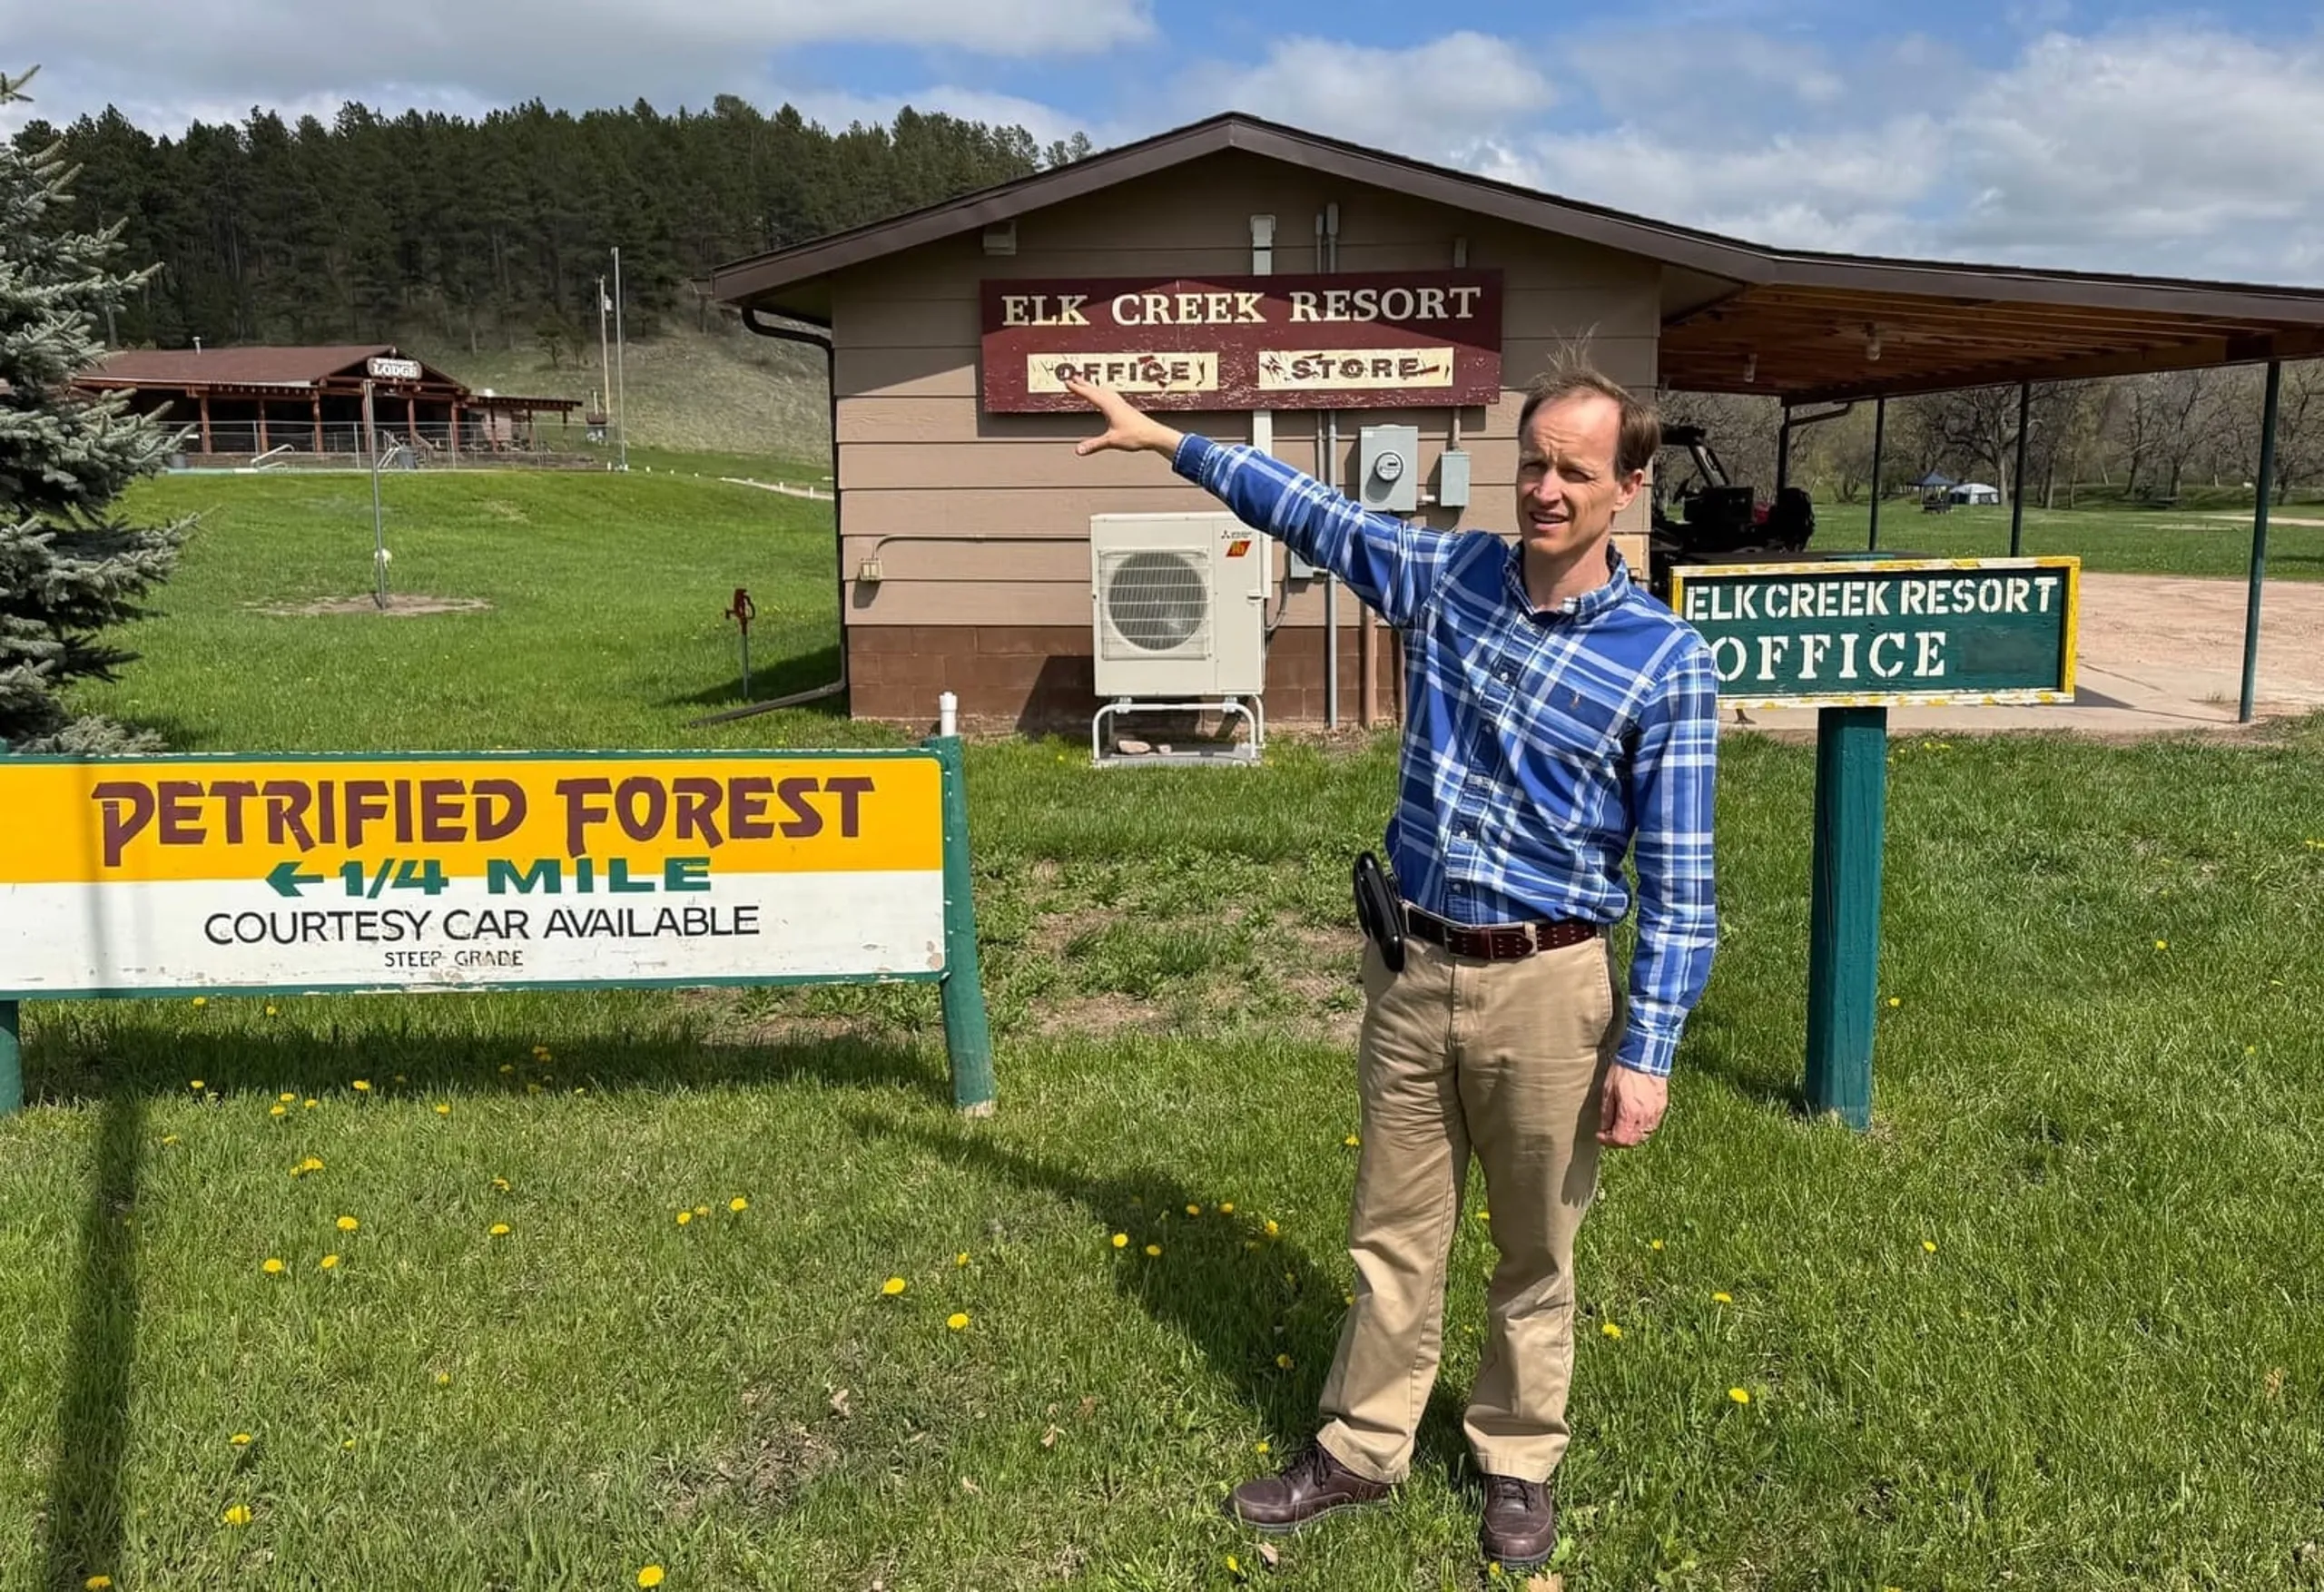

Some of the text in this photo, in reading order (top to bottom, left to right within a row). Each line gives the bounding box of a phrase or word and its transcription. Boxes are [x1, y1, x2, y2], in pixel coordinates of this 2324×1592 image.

[1001, 286, 1482, 326] ELK CREEK RESORT
[372, 363, 418, 378] LODGE
[1054, 360, 1190, 383] OFFICE
[1291, 358, 1419, 380] STORE
[1686, 576, 2058, 621] ELK CREEK RESORT
[1711, 631, 1946, 682] OFFICE
[91, 776, 875, 868] PETRIFIED FOREST
[339, 856, 712, 899] 1/4 MILE
[203, 905, 760, 946] COURTESY CAR AVAILABLE
[384, 949, 524, 968] STEEP GRADE
